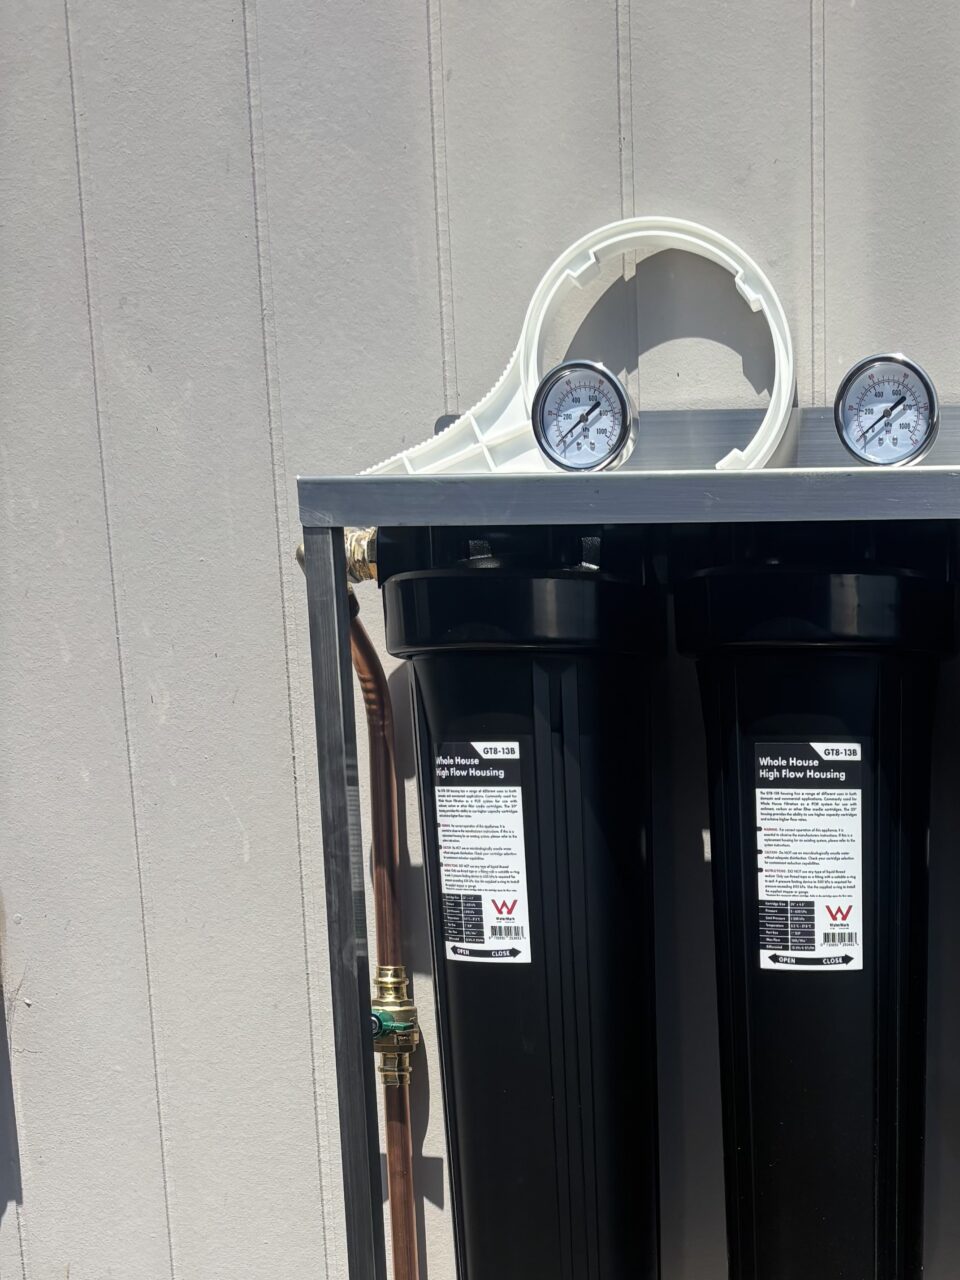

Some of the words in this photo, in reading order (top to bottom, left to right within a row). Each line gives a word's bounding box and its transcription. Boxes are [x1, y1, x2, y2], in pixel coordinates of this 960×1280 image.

[483, 747, 516, 755] GT8-13B
[824, 748, 857, 756] GT8-13B
[436, 756, 454, 765] Whole
[455, 757, 479, 765] House
[759, 757, 787, 766] Whole
[789, 757, 819, 766] House
[436, 768, 449, 779] High
[450, 768, 467, 776] Flow
[469, 768, 504, 779] Housing
[759, 769, 780, 781] High
[782, 769, 804, 778] Flow
[806, 769, 846, 781] Housing
